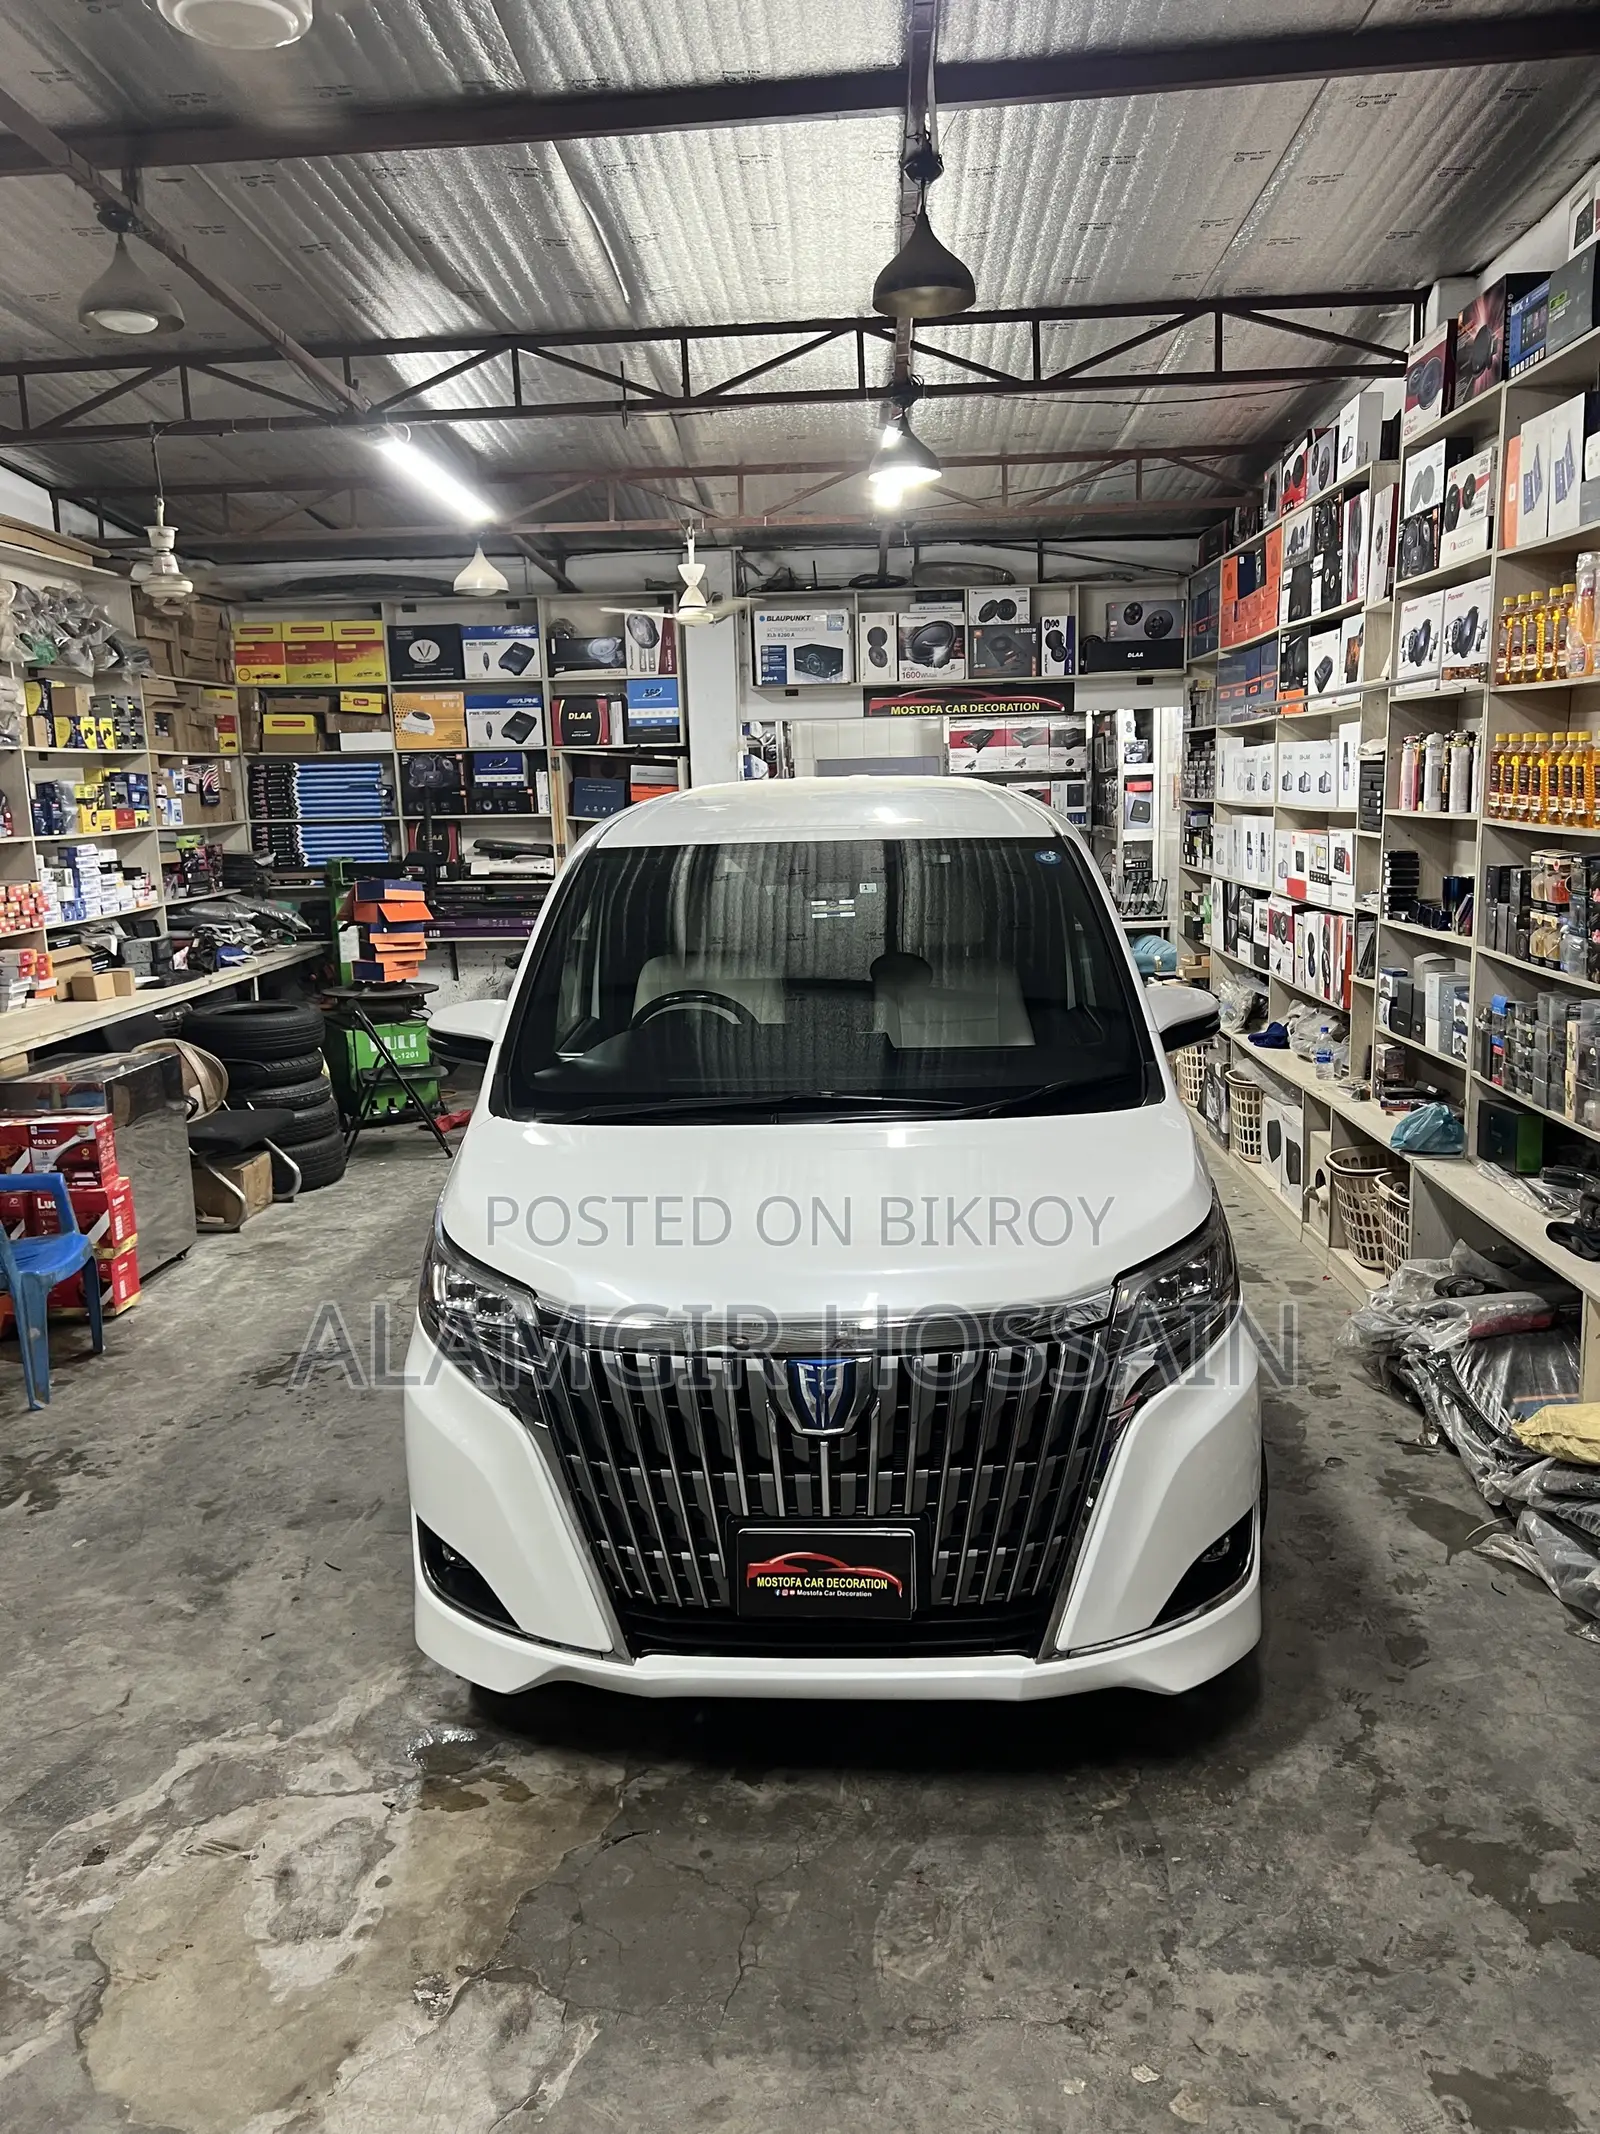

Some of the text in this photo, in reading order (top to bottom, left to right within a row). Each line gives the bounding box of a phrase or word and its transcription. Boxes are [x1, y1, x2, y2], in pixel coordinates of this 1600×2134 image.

[902, 671, 921, 679] 1600
[890, 702, 1040, 715] MOSTOFA CAR DECORATION
[568, 712, 592, 720] DLAA
[37, 1197, 57, 1209] Luc
[756, 1576, 888, 1590] MOSTOFA CAR DECORATION
